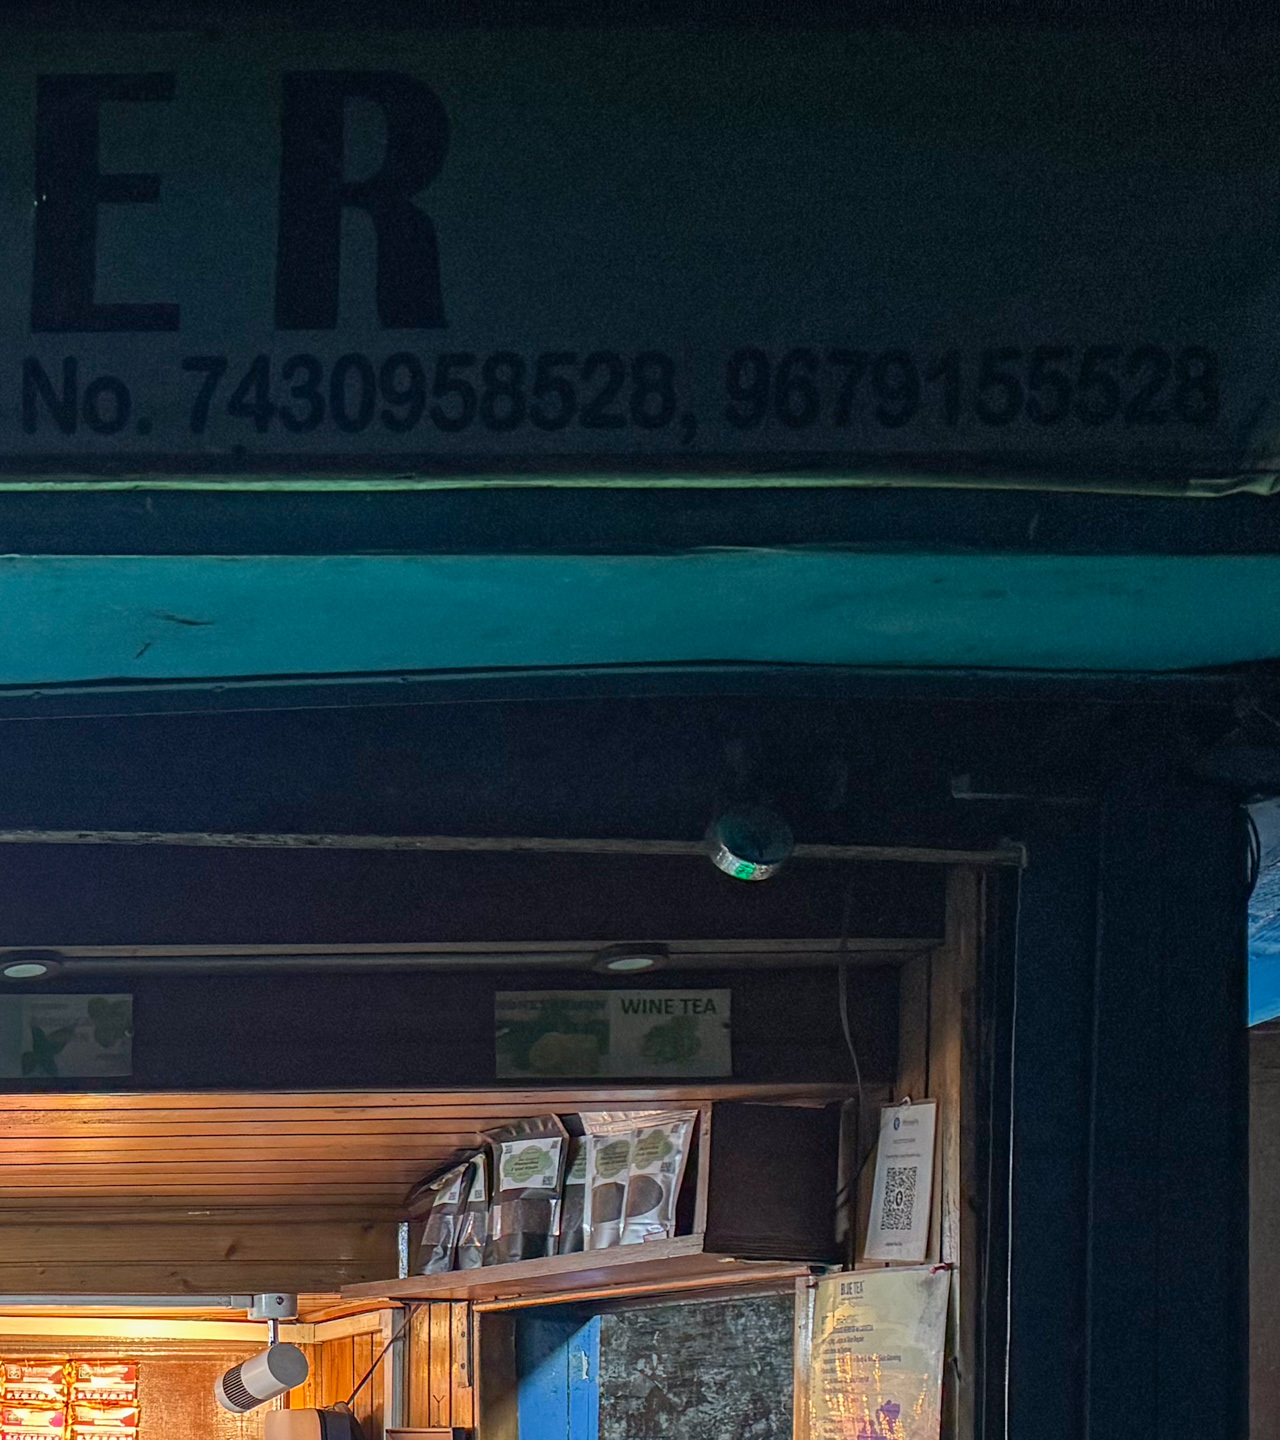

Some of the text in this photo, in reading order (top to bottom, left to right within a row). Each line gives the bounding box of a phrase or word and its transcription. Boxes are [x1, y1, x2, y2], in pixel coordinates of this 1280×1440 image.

[22, 355, 151, 436] No.
[182, 350, 702, 446] 7430958528,
[725, 344, 1221, 430] 9679155528
[620, 998, 676, 1015] WINE
[680, 998, 717, 1015] TEA
